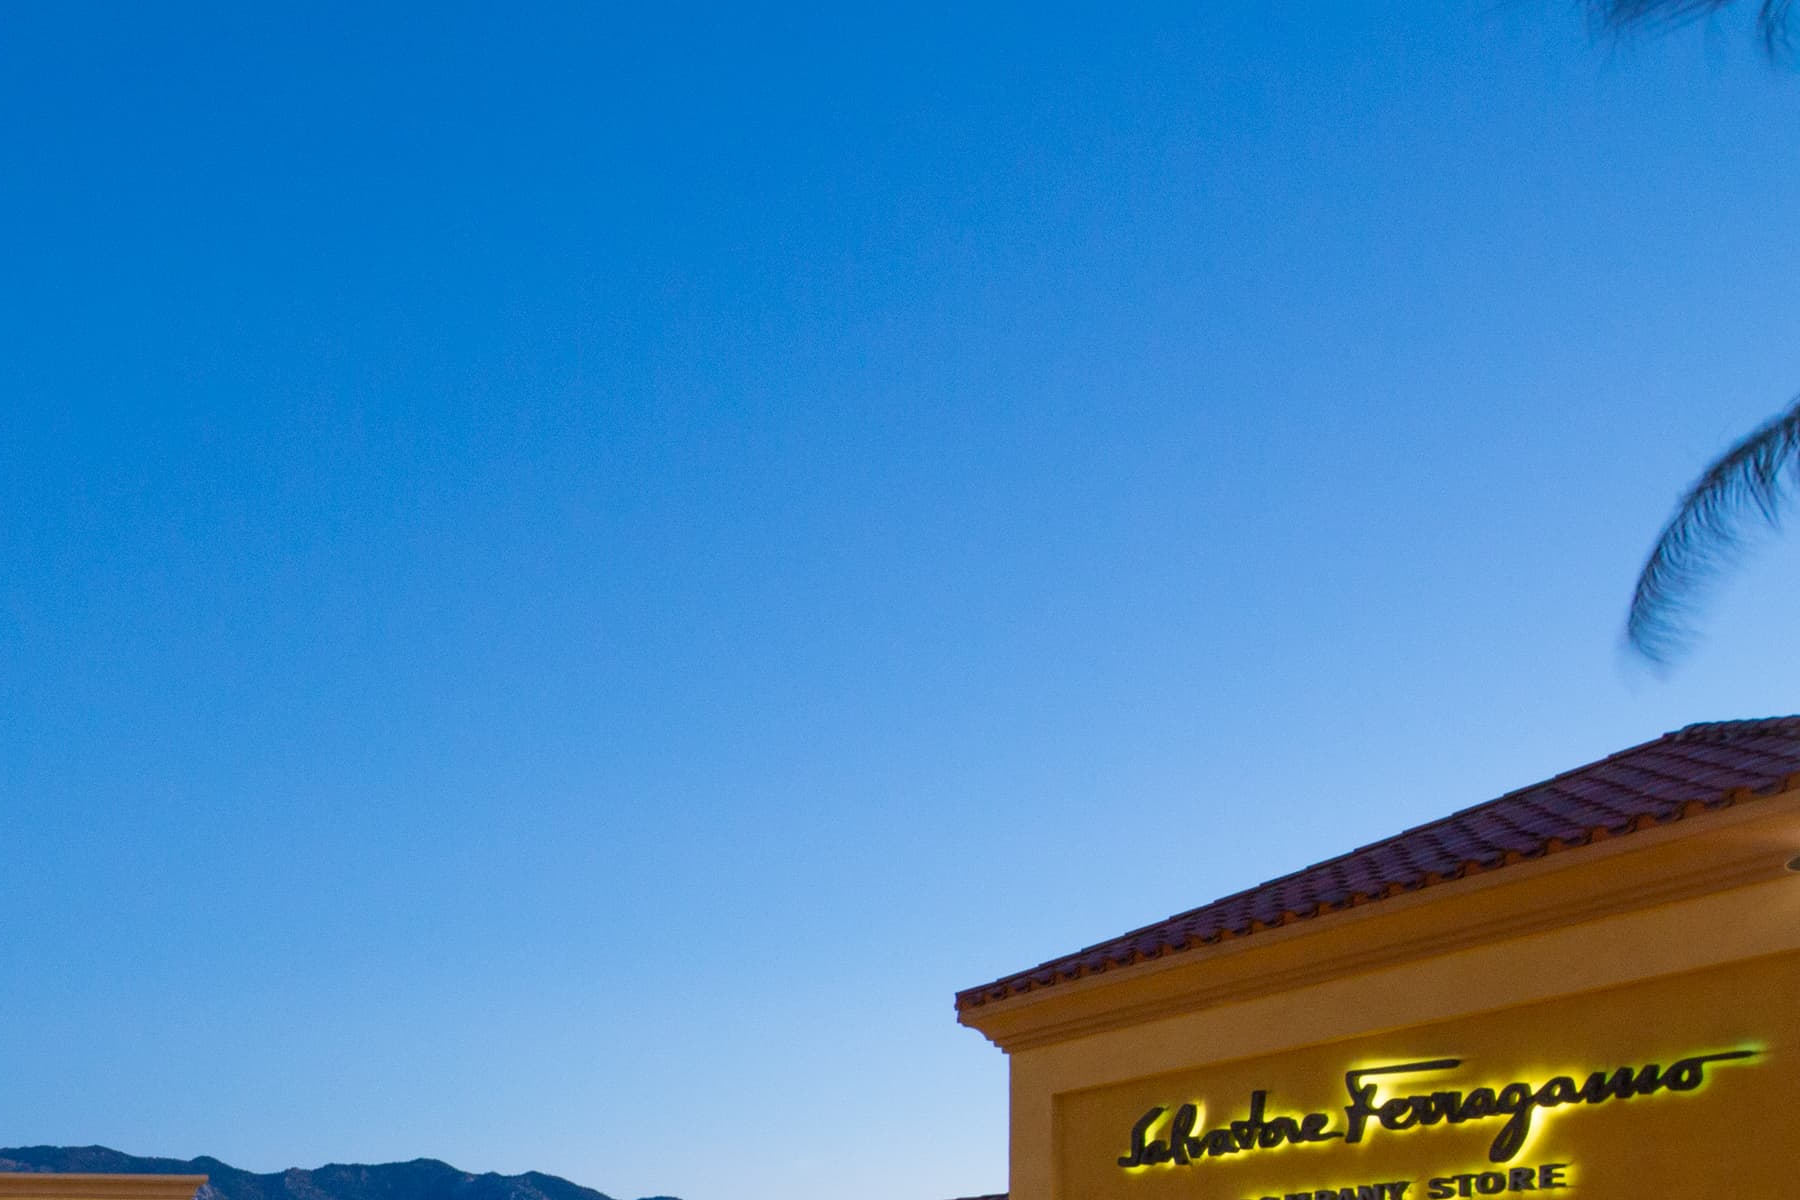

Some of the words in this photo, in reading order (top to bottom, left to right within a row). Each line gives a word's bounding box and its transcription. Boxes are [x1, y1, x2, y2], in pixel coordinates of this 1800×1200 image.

[1117, 1089, 1343, 1168] Salvatore
[1345, 1050, 1761, 1163] Ferragamo
[1427, 1163, 1571, 1200] STORE
